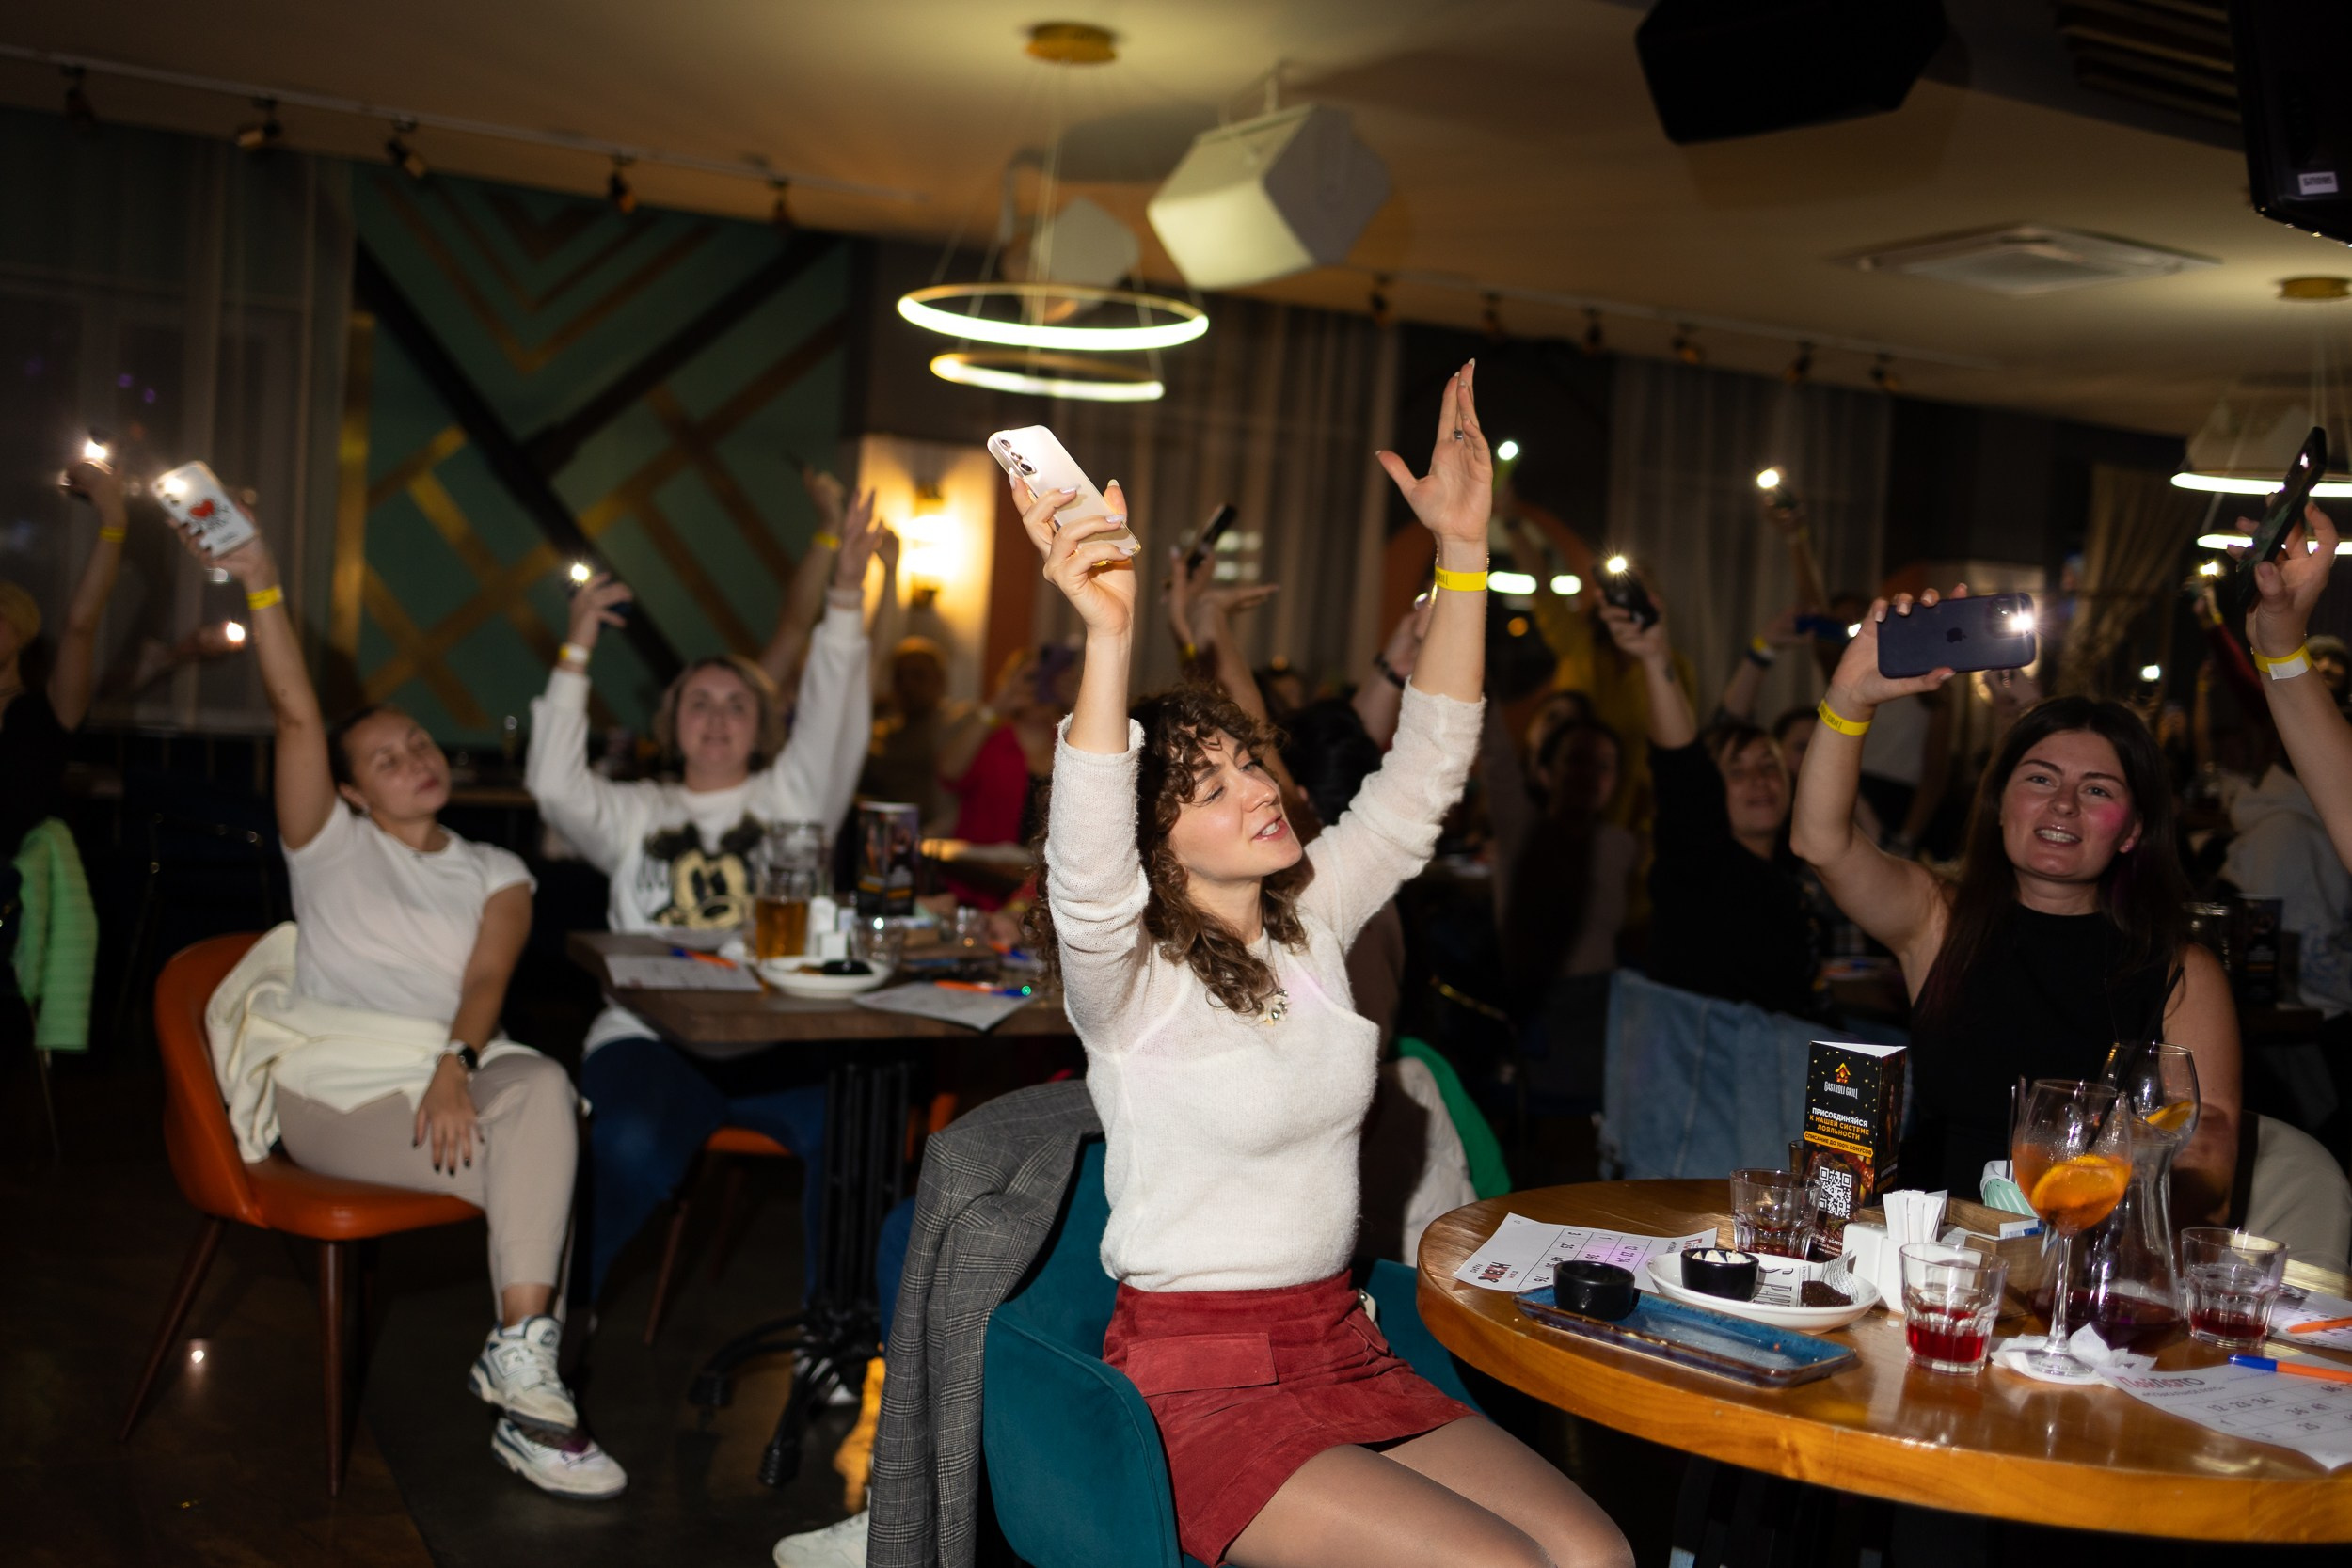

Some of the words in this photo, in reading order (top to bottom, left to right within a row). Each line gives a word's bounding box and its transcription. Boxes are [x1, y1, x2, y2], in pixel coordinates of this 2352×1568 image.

[1846, 1086, 1858, 1099] GRILL
[1812, 1107, 1868, 1128] ПРИСОЕДИНЯЙСЯ
[1815, 1117, 1838, 1127] НАШЕЙ
[1839, 1122, 1870, 1135] СИСТЕМЕ
[1817, 1124, 1860, 1141] ЛОЯЛЬНОСТИ
[1804, 1132, 1829, 1144] СПИСАНИЕ
[1836, 1141, 1849, 1149] 100%
[1849, 1145, 1872, 1155] БОНУСОВ
